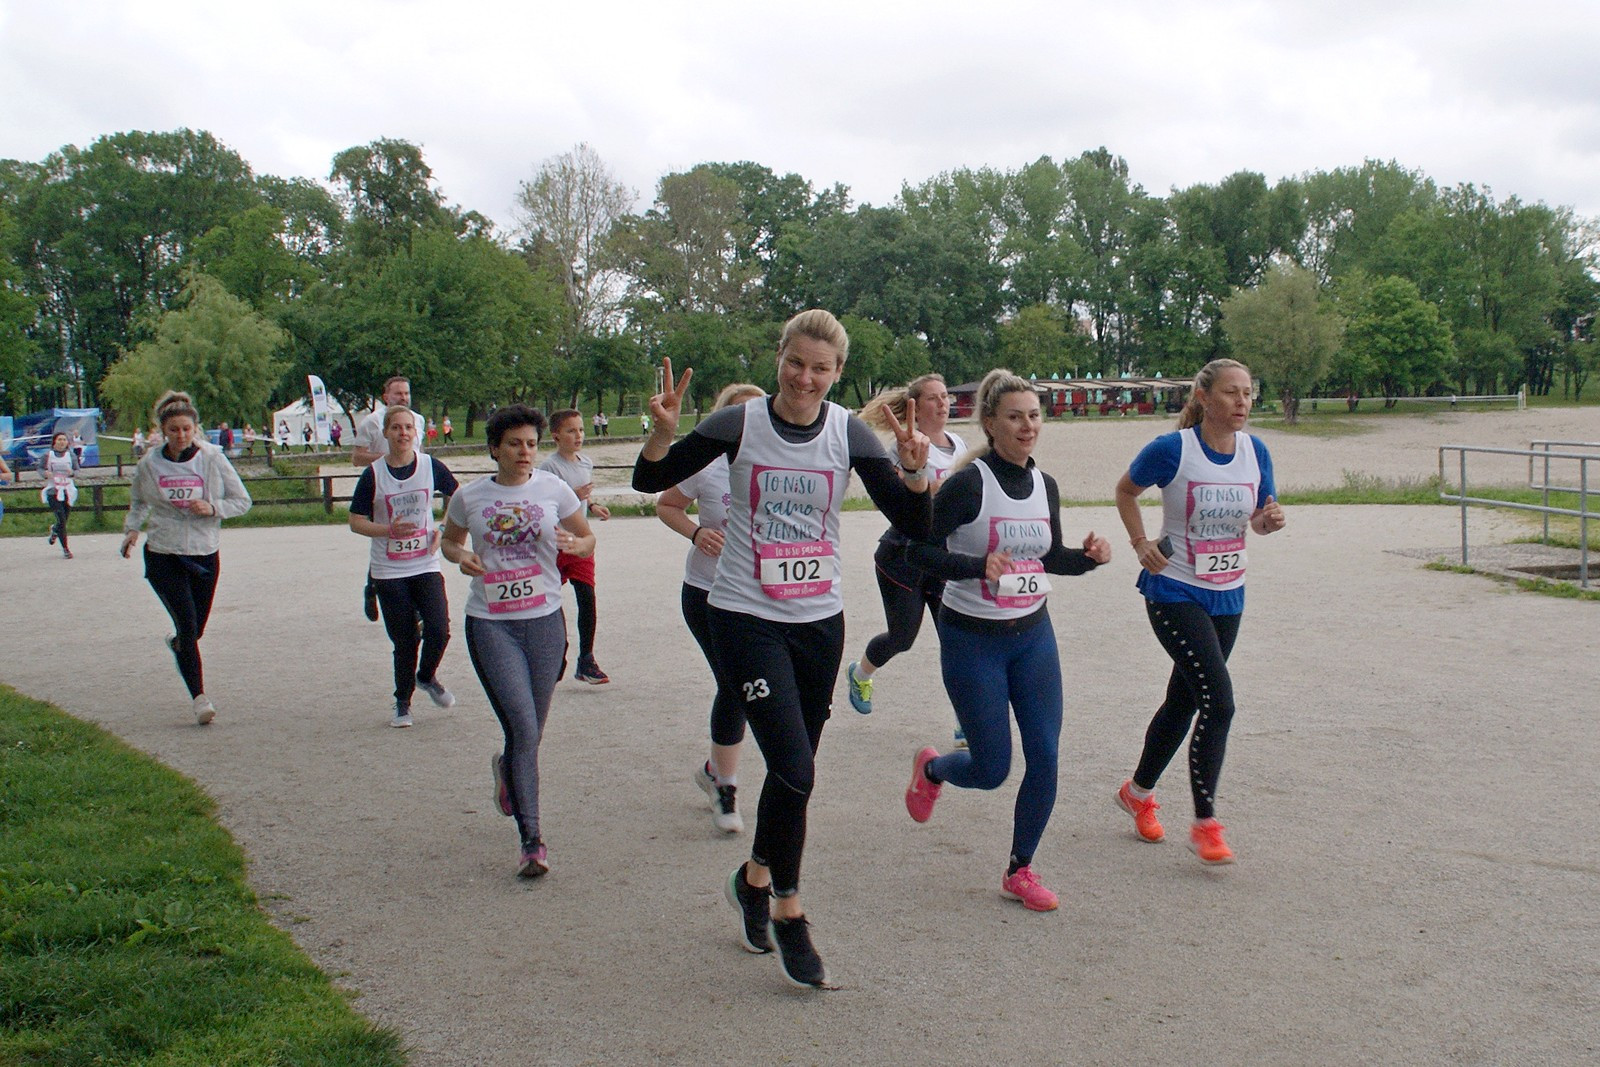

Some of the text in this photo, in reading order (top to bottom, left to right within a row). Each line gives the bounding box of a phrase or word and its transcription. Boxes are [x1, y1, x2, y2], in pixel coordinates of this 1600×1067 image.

[764, 472, 779, 492] TO
[168, 488, 193, 499] 207
[395, 538, 420, 552] 342
[778, 559, 820, 581] 102
[1208, 553, 1240, 572] 252
[497, 580, 534, 600] 265
[1017, 575, 1038, 594] 26
[742, 678, 770, 702] 23
